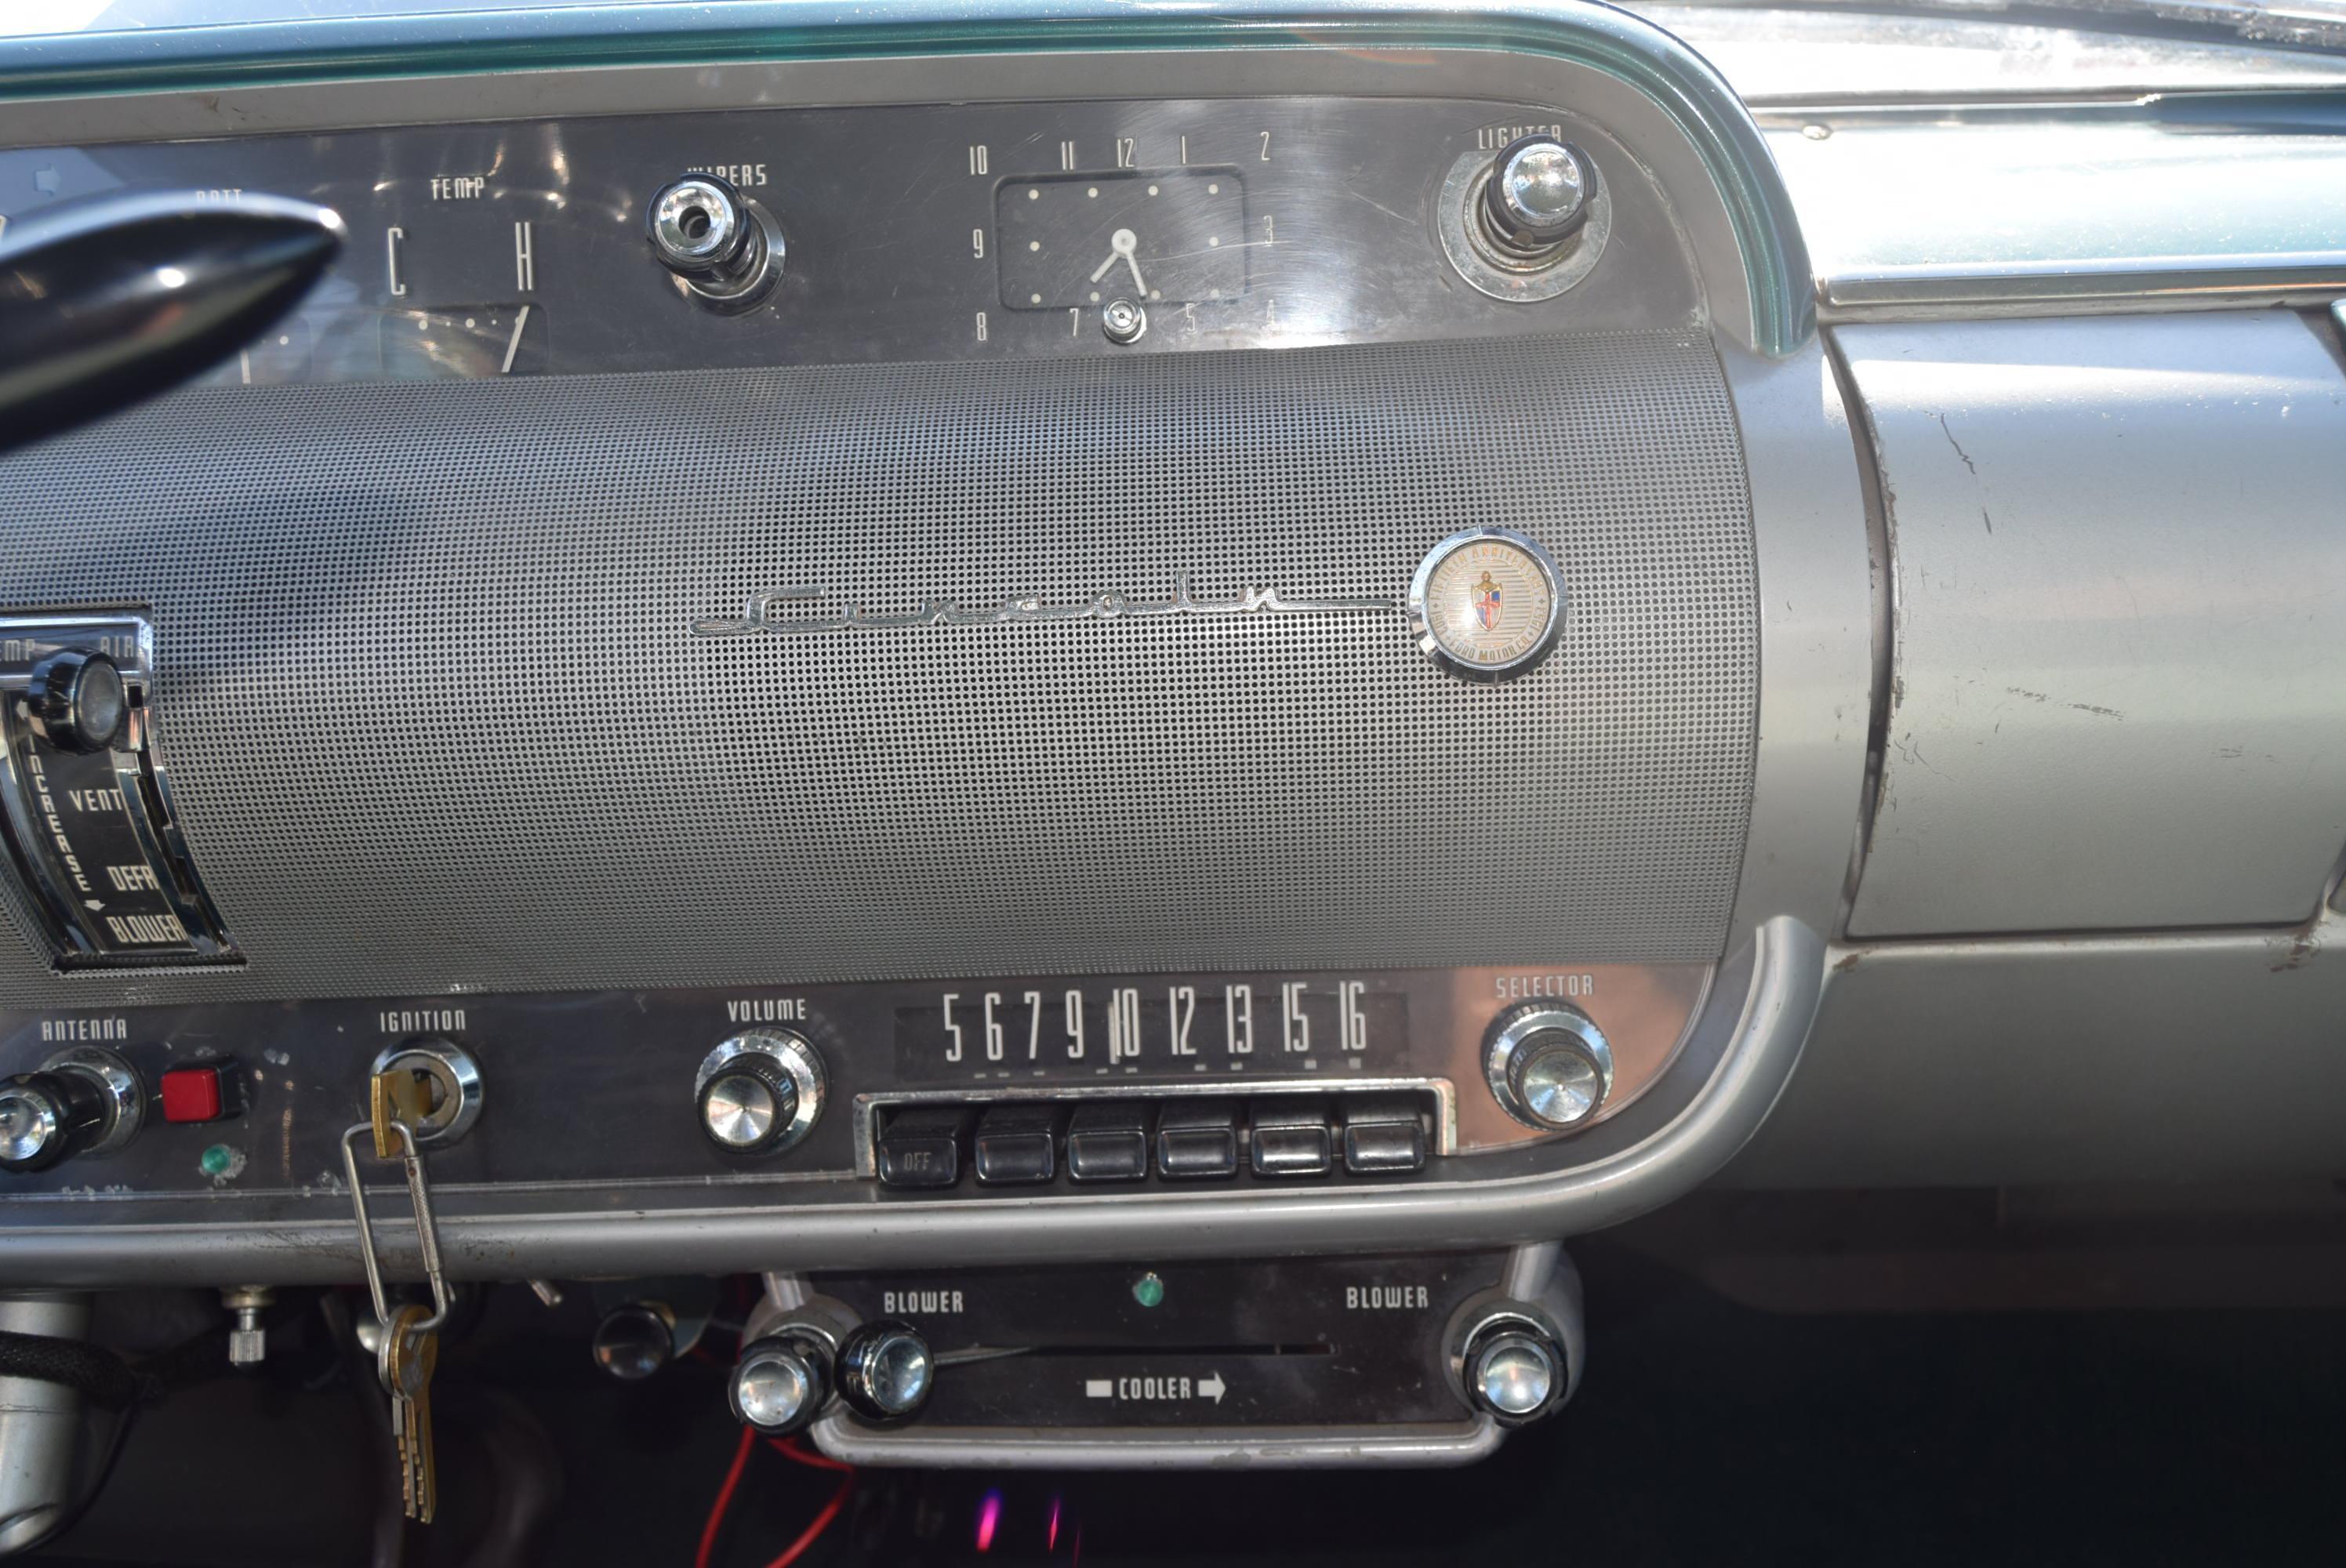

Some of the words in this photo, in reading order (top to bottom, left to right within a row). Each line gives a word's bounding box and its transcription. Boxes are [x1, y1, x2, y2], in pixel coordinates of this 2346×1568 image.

[969, 145, 988, 176] 10
[1061, 140, 1077, 171] 11
[1116, 137, 1137, 168] 12
[1180, 136, 1188, 165] 1
[1260, 131, 1271, 162] 2
[430, 175, 486, 201] TEMP
[687, 163, 768, 187] PERS
[1262, 215, 1273, 247] 3
[514, 221, 533, 292] H
[972, 229, 983, 260] 9
[387, 227, 406, 296] C
[975, 311, 987, 342] 8
[1069, 307, 1079, 337] 7
[1186, 302, 1197, 332] 5
[0, 638, 36, 662] MP
[100, 635, 134, 659] AIR
[1449, 639, 1475, 659] FORD
[1478, 644, 1517, 661] MOTOR
[27, 734, 93, 891] INCREASE
[67, 789, 124, 812] VENT
[105, 914, 188, 943] BLOWER
[1496, 975, 1594, 998] SELECTOR
[380, 1009, 467, 1033] IGNITION
[726, 997, 807, 1023] VOLUME
[943, 993, 962, 1062] 5
[985, 992, 1004, 1061] 6
[1024, 991, 1041, 1059] 7
[1066, 990, 1084, 1058] 9
[1113, 988, 1140, 1057] 10
[1169, 985, 1197, 1056] 12
[1226, 984, 1253, 1054] 13
[1282, 982, 1309, 1052] 15
[1339, 980, 1367, 1051] 16
[42, 1018, 129, 1041] ANTENNA
[903, 1152, 932, 1171] OFF
[883, 1290, 964, 1315] BLOWER
[1346, 1285, 1429, 1310] BLOWER
[1117, 1374, 1193, 1401] COOLER
